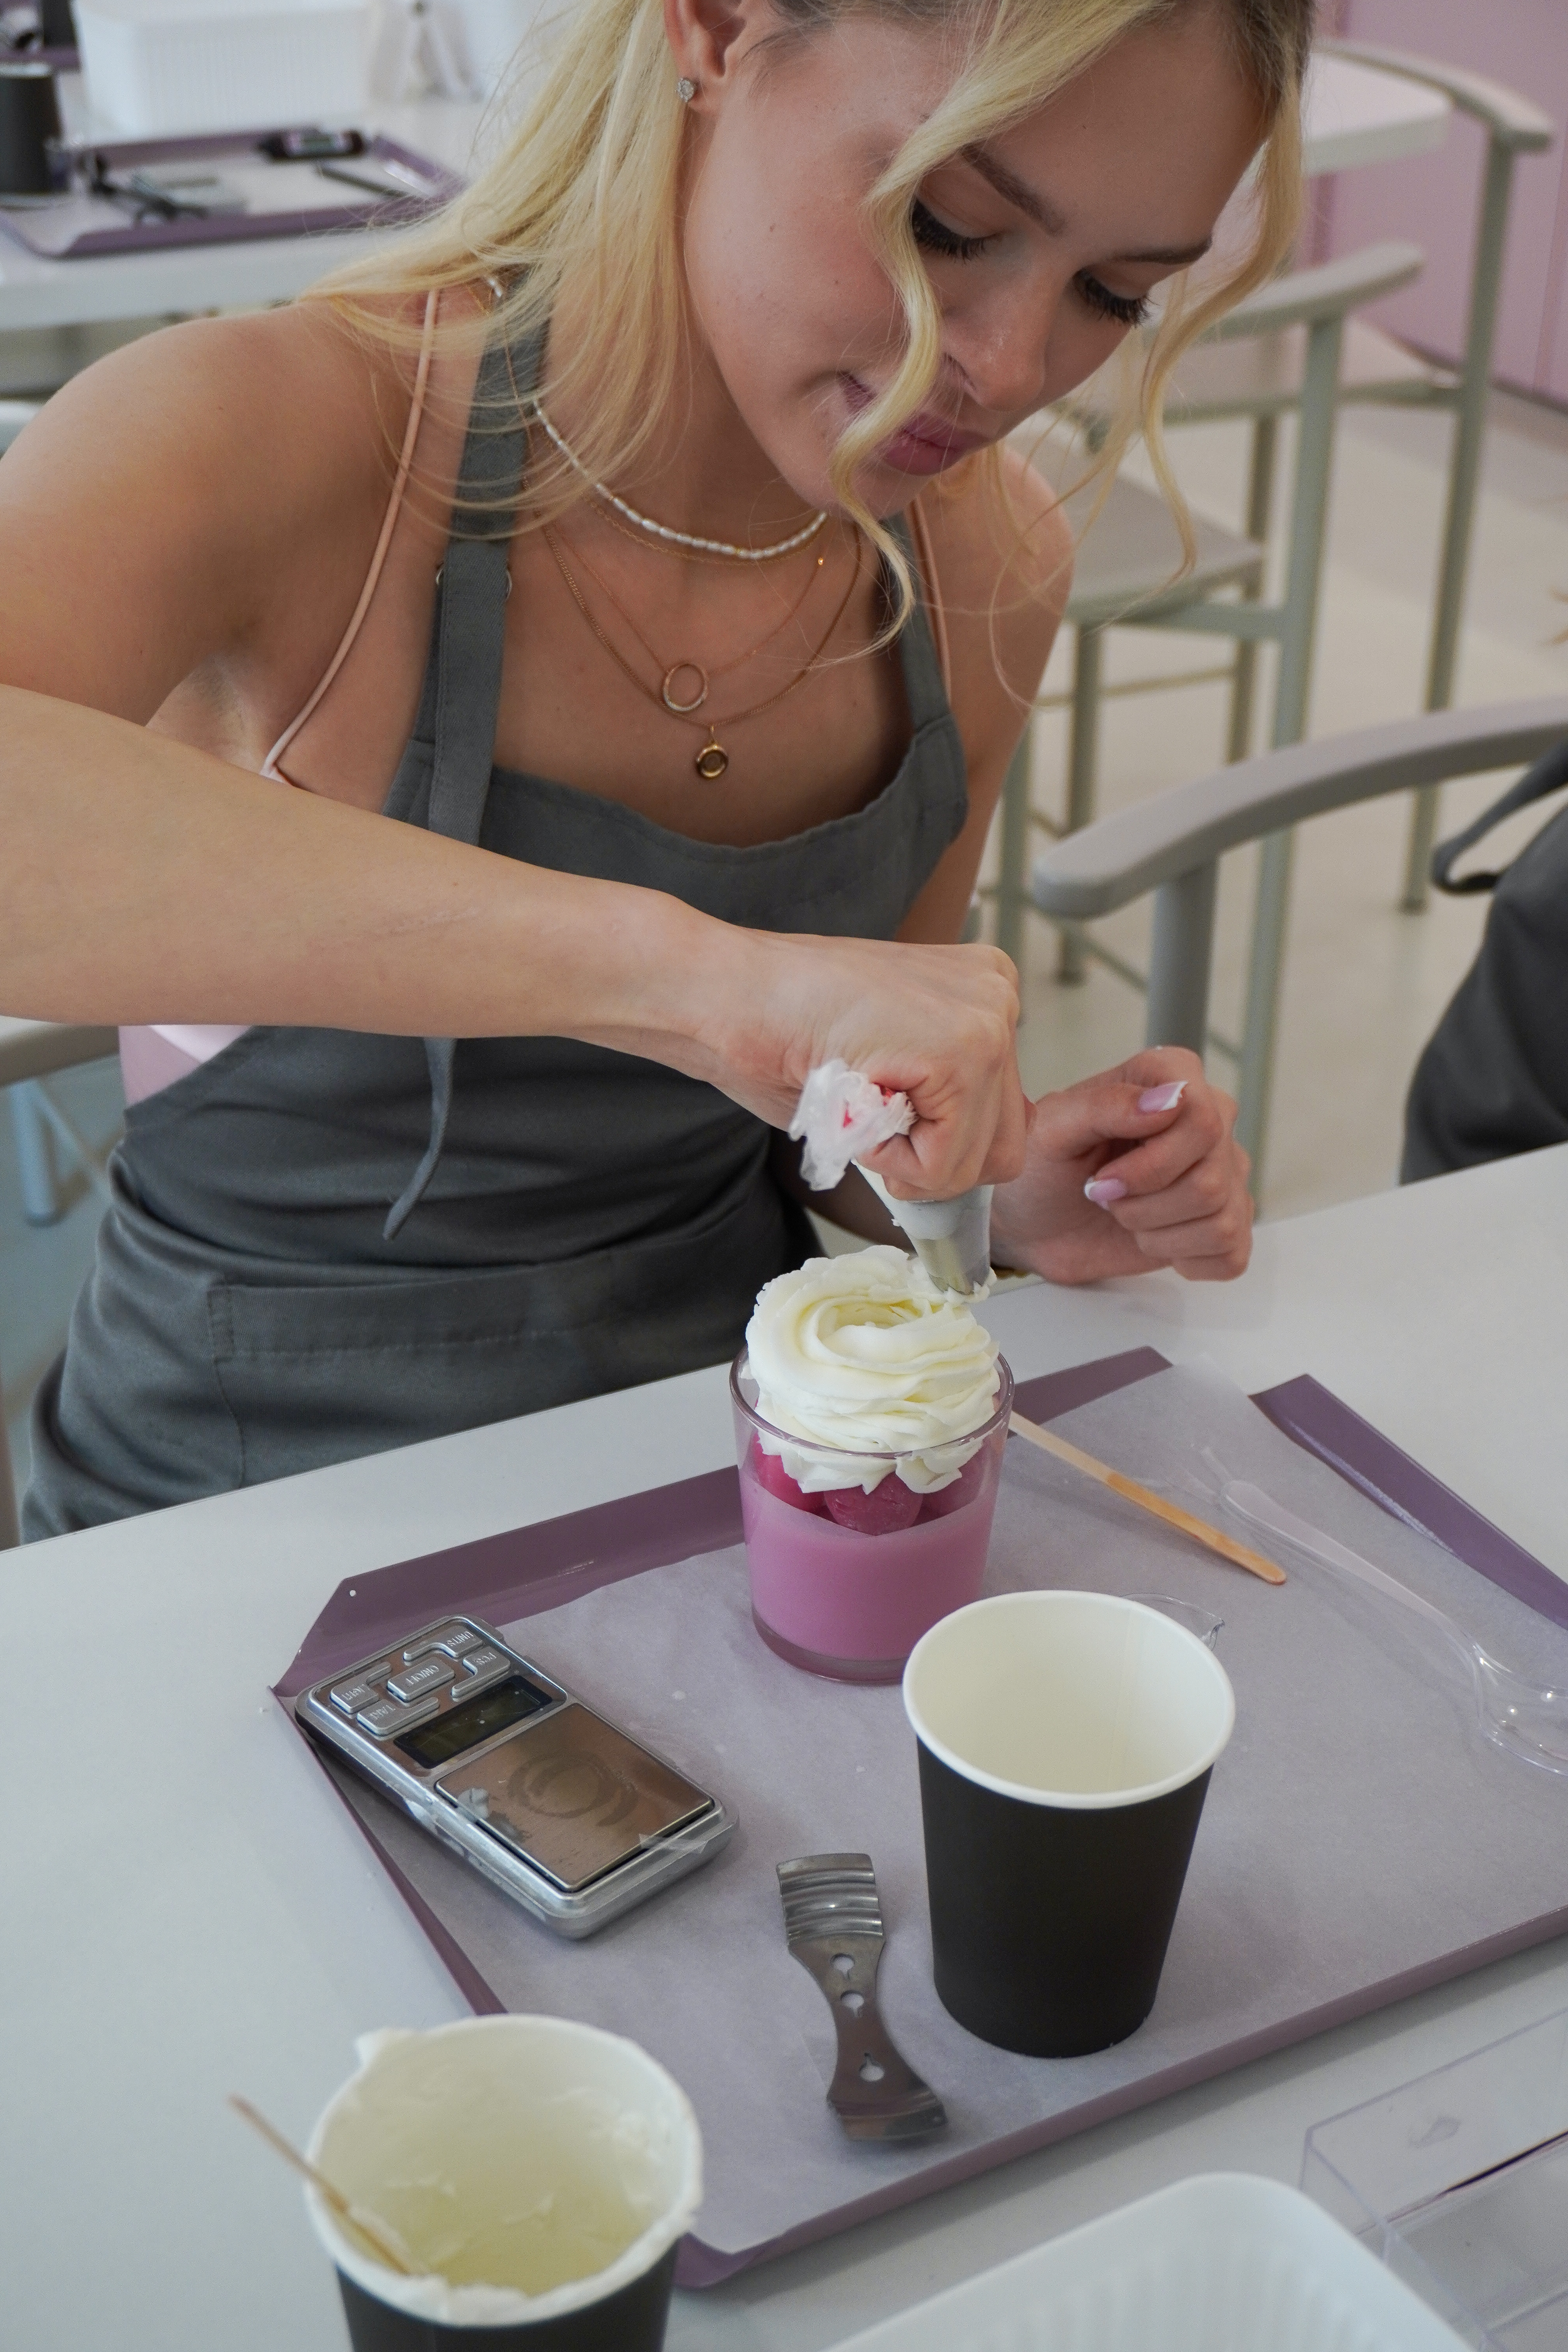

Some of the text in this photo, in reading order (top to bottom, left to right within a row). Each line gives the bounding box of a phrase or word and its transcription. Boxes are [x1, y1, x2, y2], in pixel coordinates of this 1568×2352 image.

[446, 1631, 474, 1647] UNITS
[474, 1652, 497, 1665] PCS
[405, 1665, 439, 1685] ON/OFF
